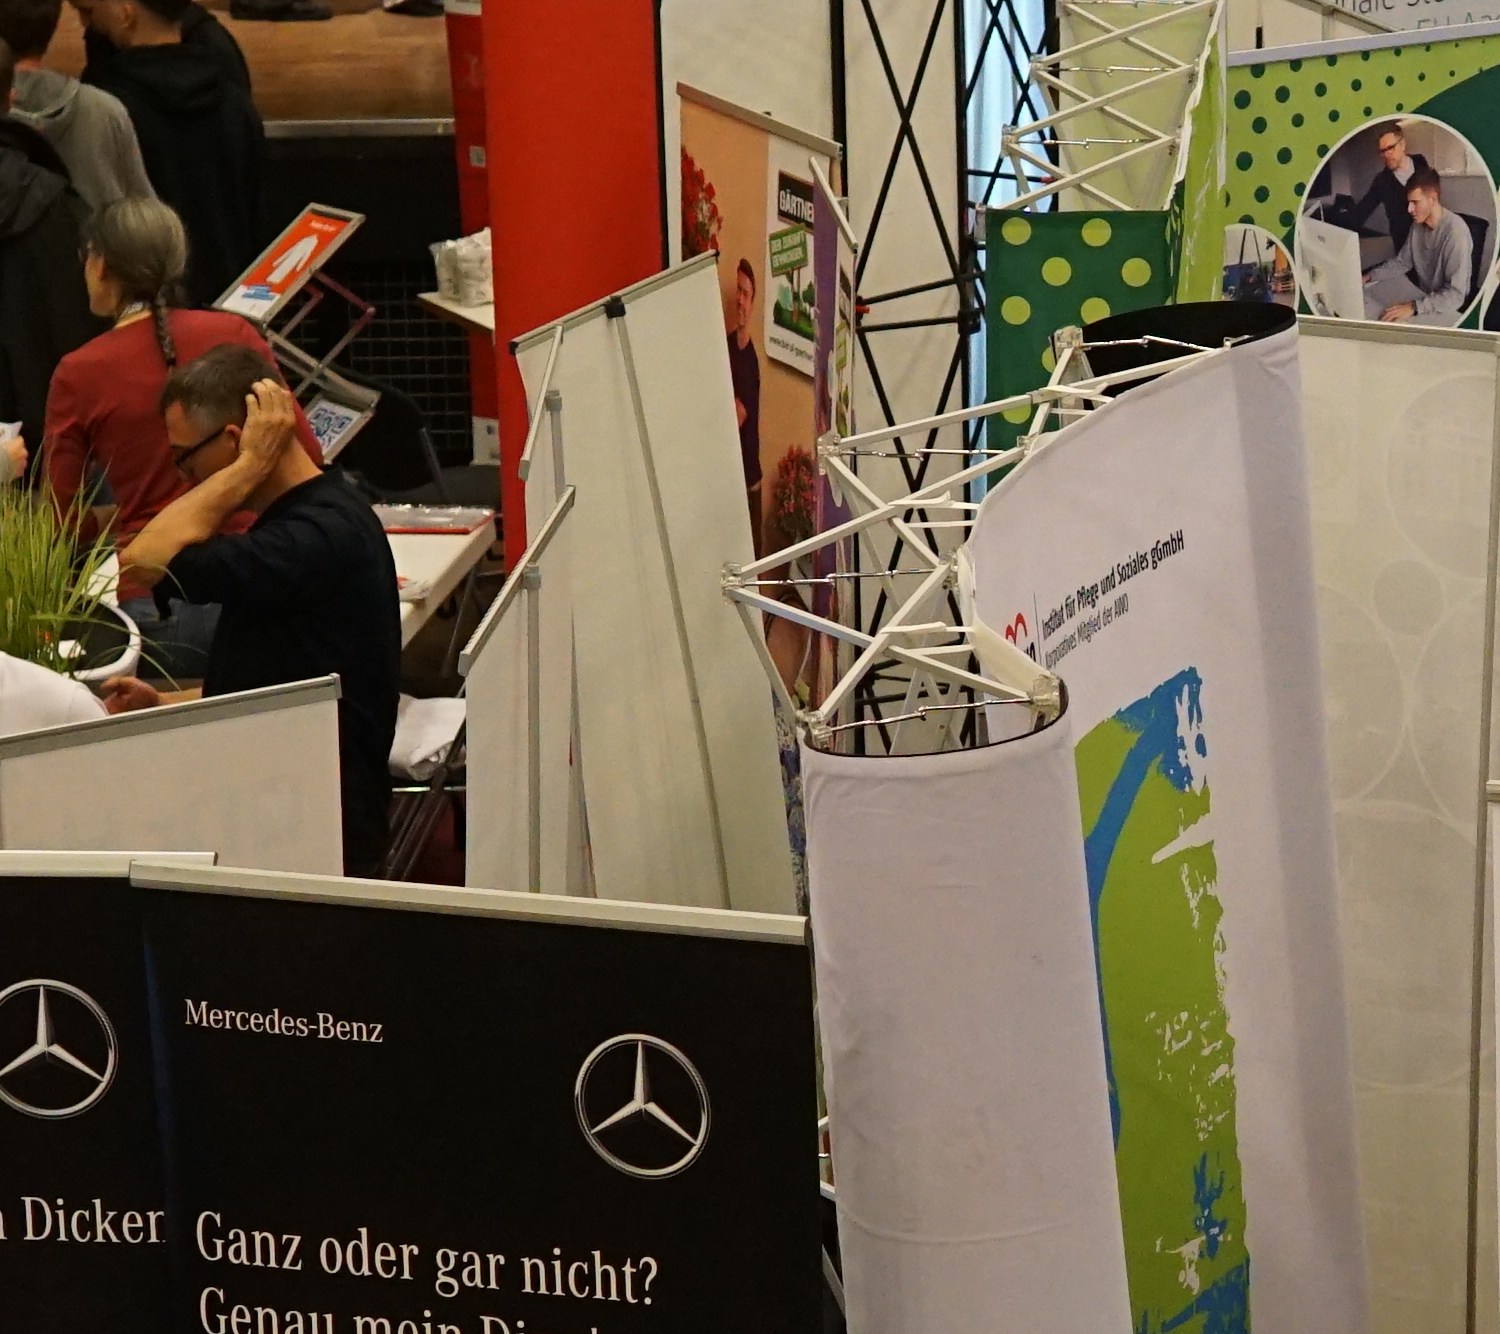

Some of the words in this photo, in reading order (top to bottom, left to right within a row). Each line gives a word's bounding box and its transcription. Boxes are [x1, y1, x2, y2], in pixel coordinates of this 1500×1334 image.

[1100, 566, 1115, 596] und
[1117, 551, 1148, 585] Soziales
[1151, 529, 1184, 570] gGmbH
[184, 998, 383, 1043] Mercedes-Benz
[196, 1210, 302, 1271] Ganz
[319, 1226, 419, 1280] oder
[435, 1248, 506, 1298] gar
[520, 1247, 658, 1306] nicht?
